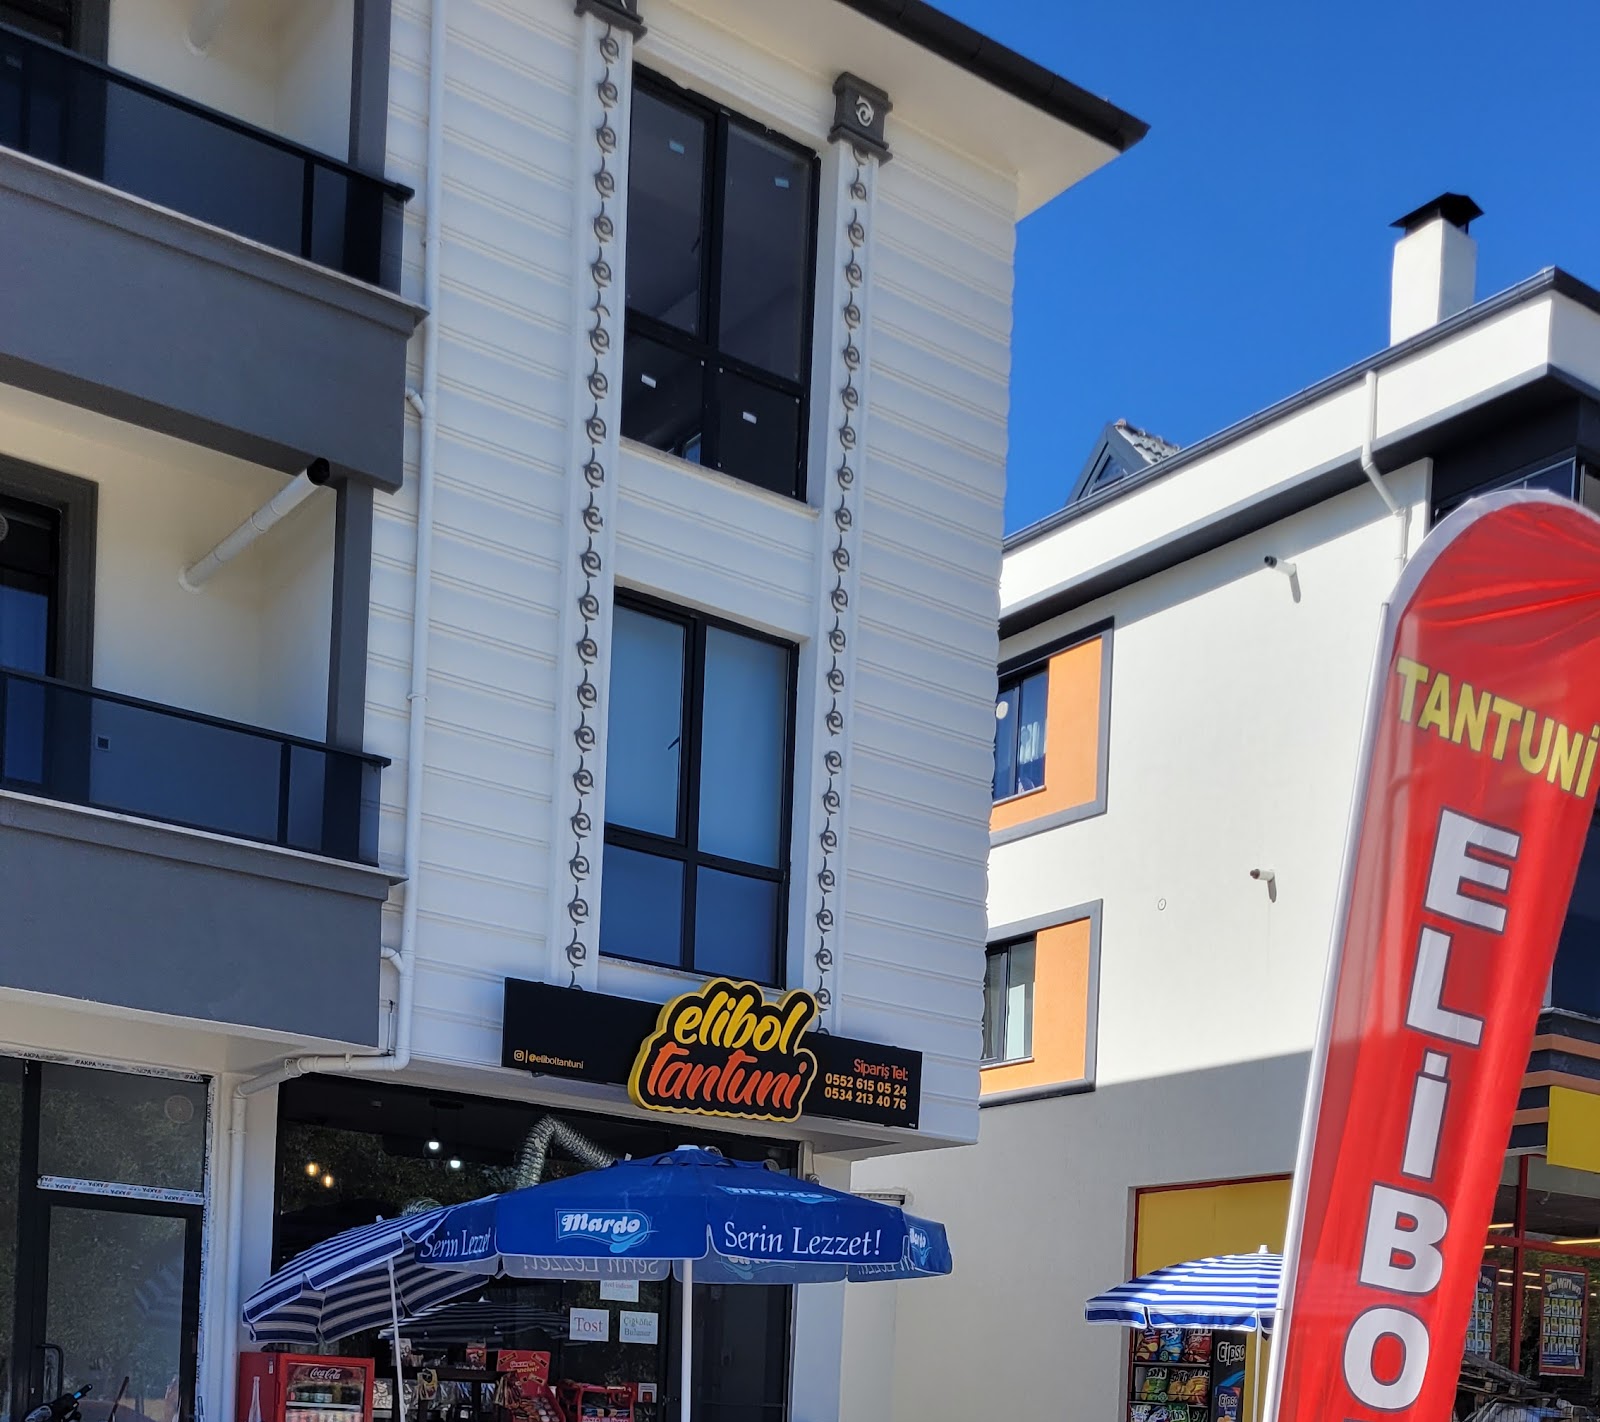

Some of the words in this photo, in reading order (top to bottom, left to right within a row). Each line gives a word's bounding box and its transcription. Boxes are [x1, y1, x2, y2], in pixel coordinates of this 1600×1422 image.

[673, 990, 808, 1054] elibol
[646, 1041, 807, 1109] tantuni
[853, 1058, 890, 1079] Sipariş
[825, 1073, 854, 1088] 0552
[856, 1078, 874, 1091] 615
[877, 1081, 891, 1094] 05
[893, 1084, 907, 1097] 24
[824, 1086, 852, 1101] 0534
[855, 1091, 873, 1105] 213
[876, 1096, 890, 1107] 40
[893, 1099, 907, 1110] 76
[561, 1213, 641, 1234] Mardo
[420, 1232, 458, 1257] Serin
[724, 1221, 784, 1253] Serin
[792, 1226, 881, 1256] Lezzet!
[574, 1316, 604, 1332] Tost
